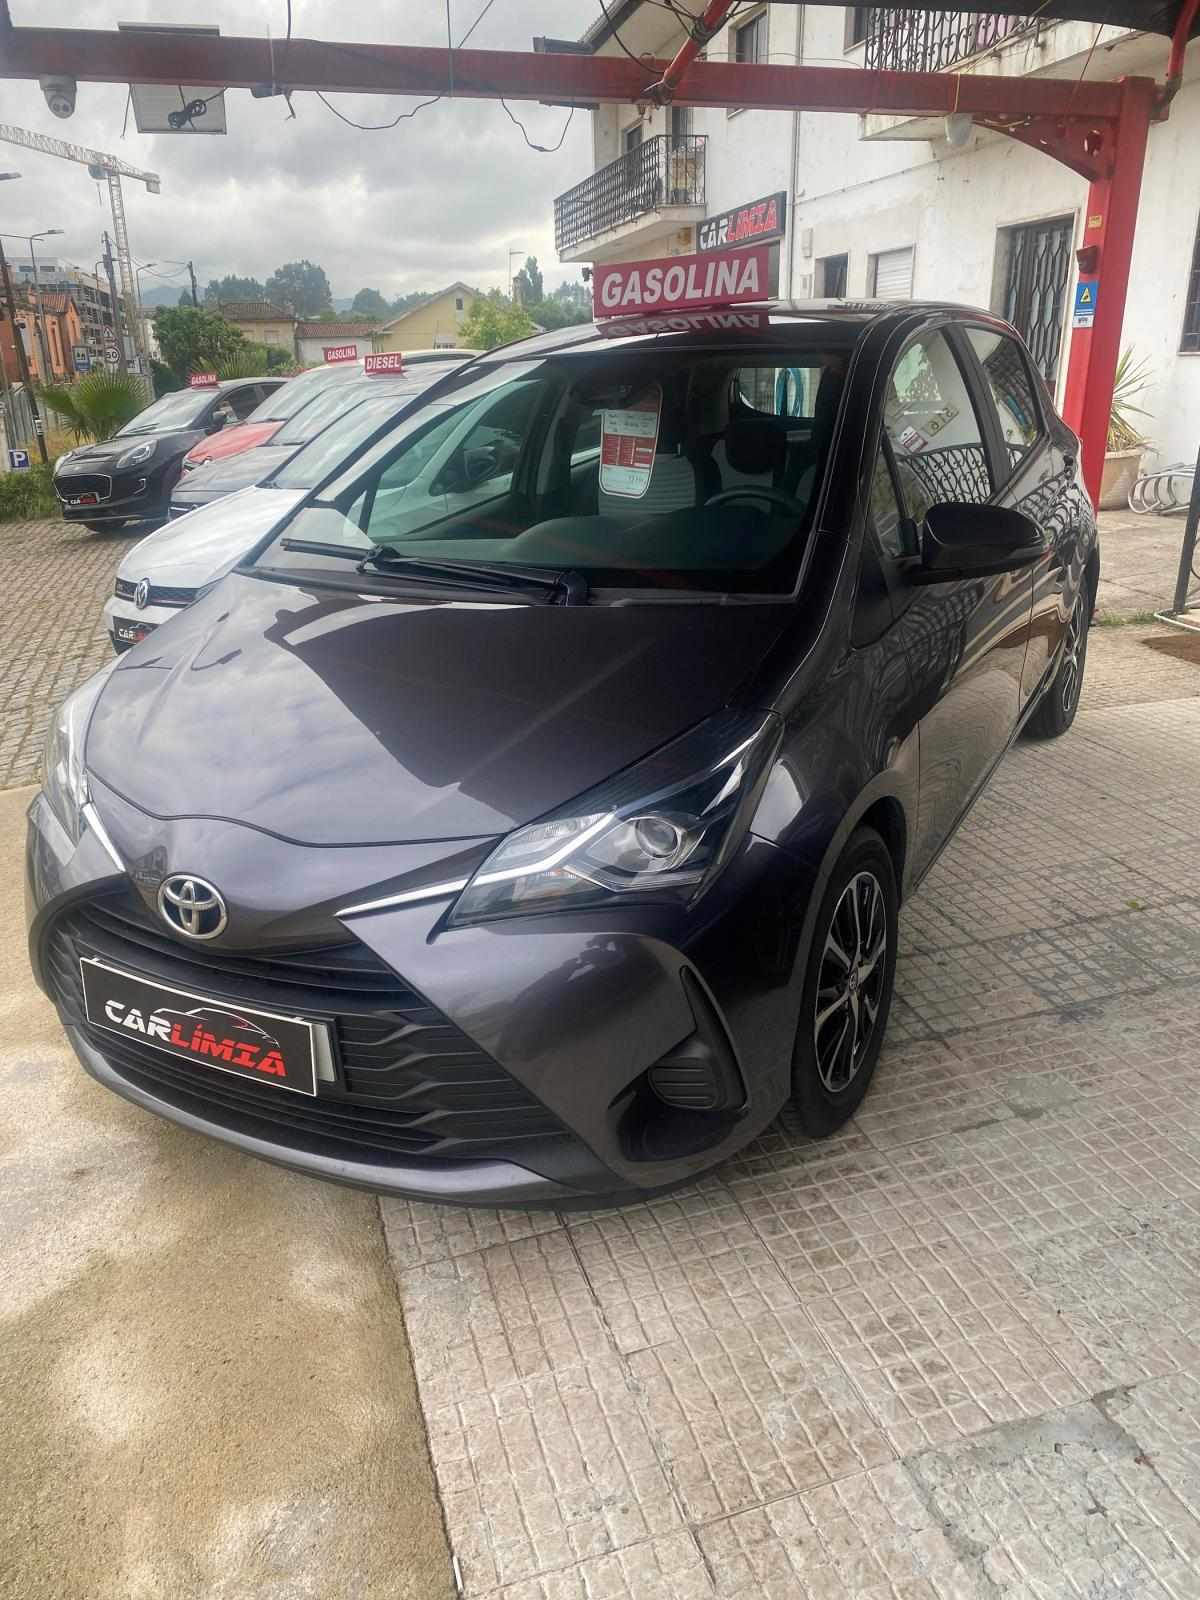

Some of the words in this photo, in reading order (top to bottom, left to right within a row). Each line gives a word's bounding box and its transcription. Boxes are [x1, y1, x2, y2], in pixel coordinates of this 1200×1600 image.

[602, 257, 760, 308] GASOLINA
[105, 350, 118, 360] 50
[327, 347, 356, 360] GASOLINA
[366, 355, 401, 369] DIESEL
[13, 451, 26, 467] P
